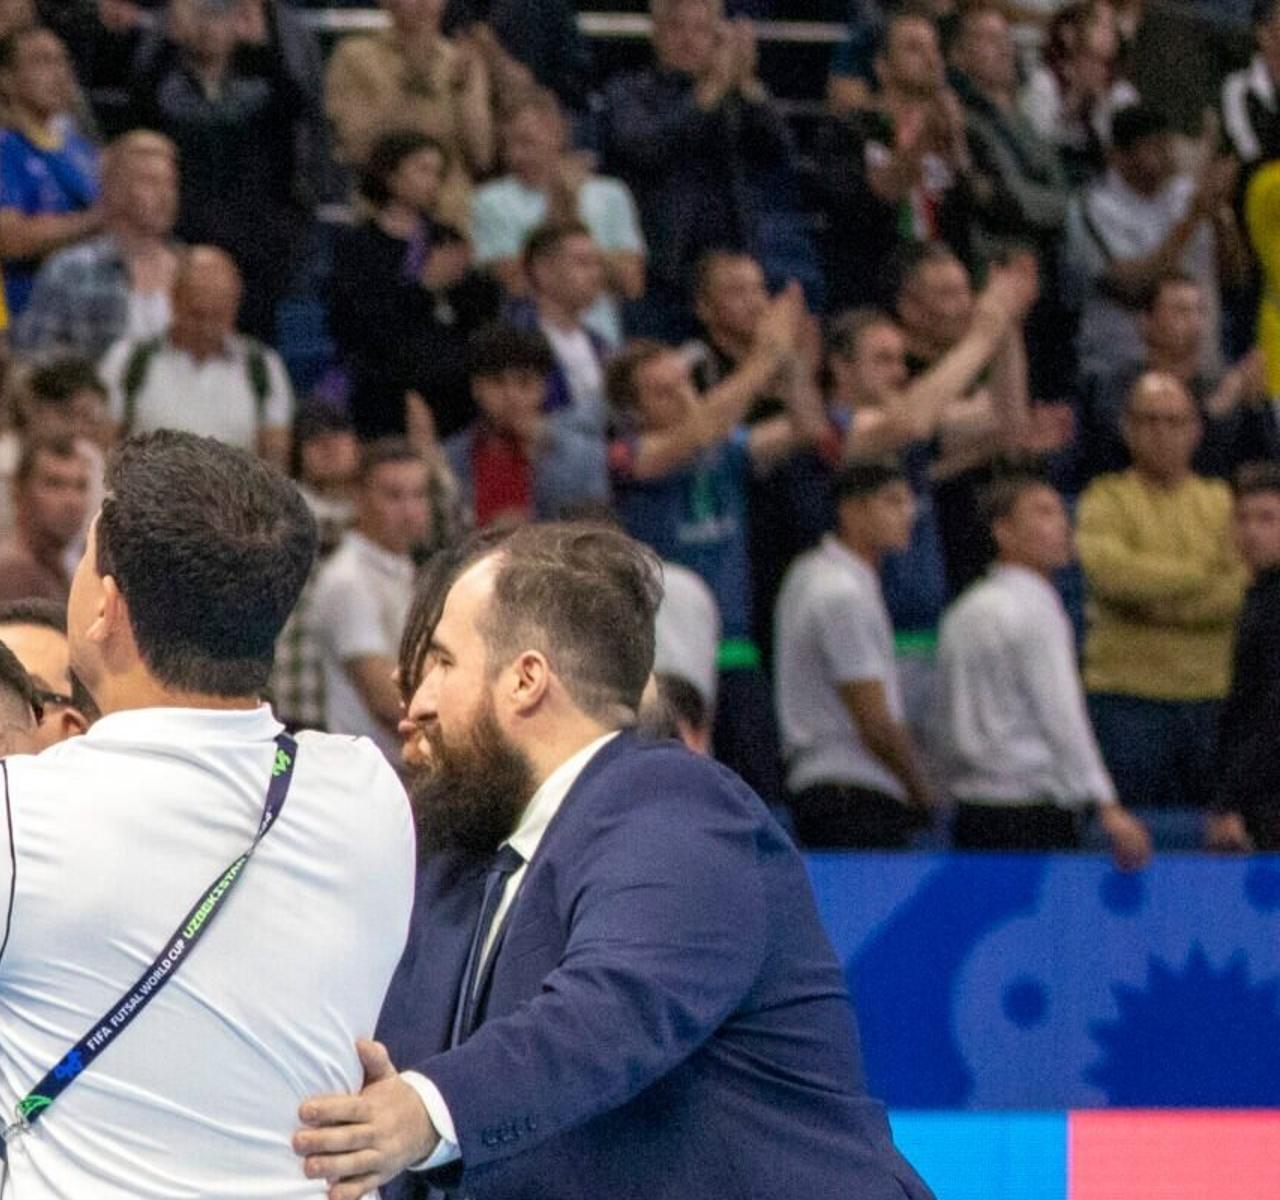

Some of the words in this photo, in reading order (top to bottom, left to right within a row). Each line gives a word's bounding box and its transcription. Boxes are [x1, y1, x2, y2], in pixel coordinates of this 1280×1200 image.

[86, 1026, 113, 1051] FIFA
[110, 990, 143, 1028] FUTSAL
[140, 958, 171, 997] WORLD
[167, 938, 186, 962] CUP
